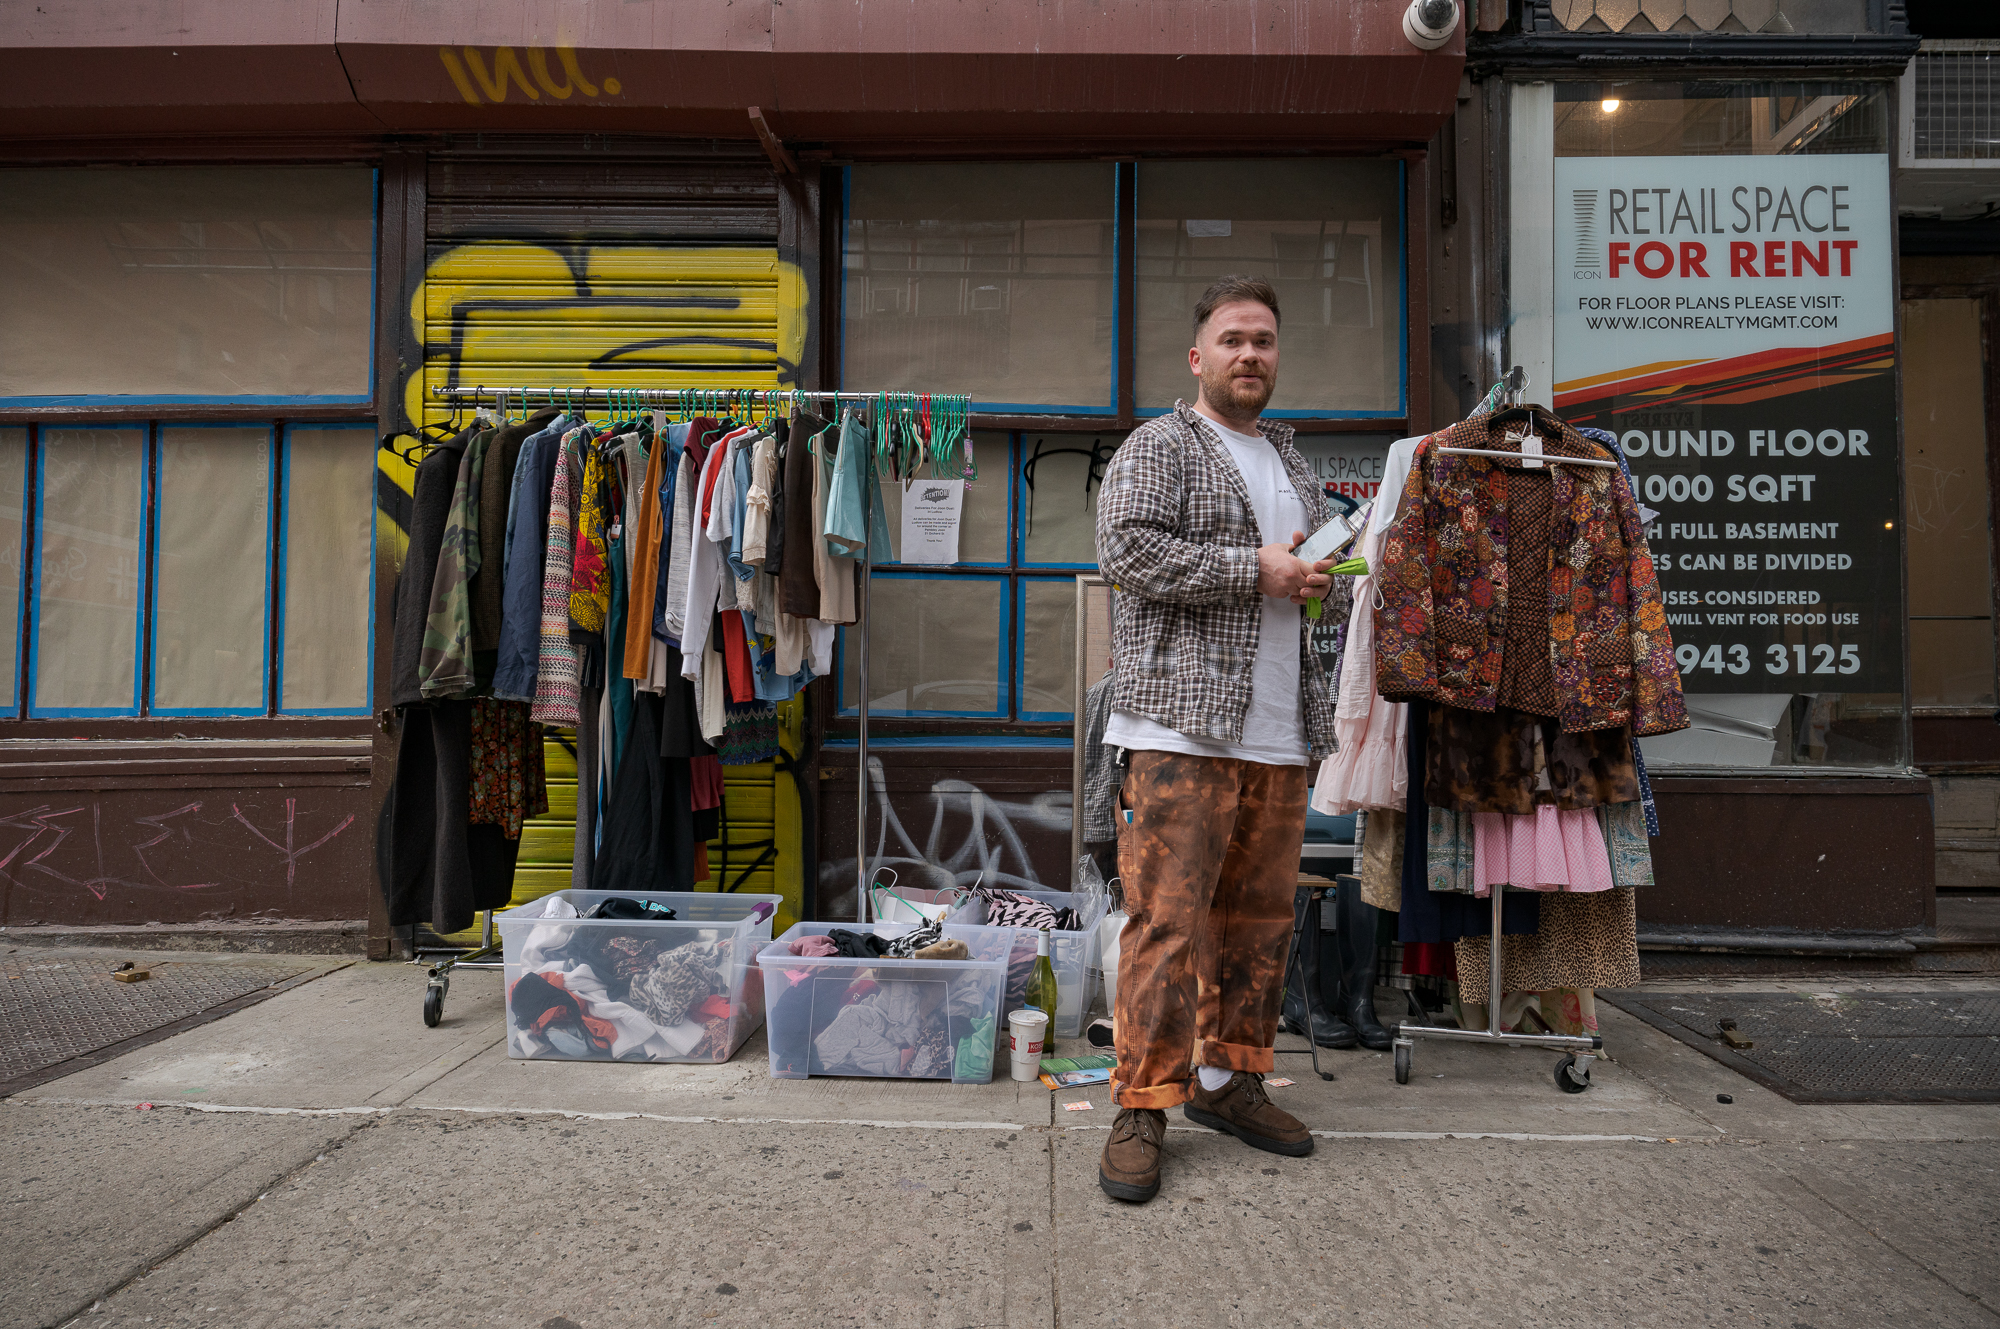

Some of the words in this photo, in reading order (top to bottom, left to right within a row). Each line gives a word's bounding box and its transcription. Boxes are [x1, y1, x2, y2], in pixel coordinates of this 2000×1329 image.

[1610, 187, 1725, 234] RETAIL
[1731, 185, 1850, 233] SPACE
[1609, 240, 1710, 279] FOR
[1730, 240, 1859, 278] RENT
[1573, 270, 1602, 280] ICON
[1579, 297, 1612, 310] FOR
[1617, 297, 1671, 310] FLOOR
[1675, 297, 1730, 310] PLANS
[1735, 296, 1797, 309] PLEASE
[1800, 296, 1845, 309] VISIT:
[1586, 315, 1838, 330] WWW.ICONREALTYMGMT.COM
[1605, 429, 1735, 457] OUND
[1749, 429, 1871, 457] FLOOR
[1328, 456, 1381, 479] SPACE
[1727, 474, 1816, 503] SQFT
[1670, 523, 1719, 540] FULL
[1725, 523, 1839, 540] BASEMENT
[1679, 553, 1726, 571] CAN
[1733, 554, 1758, 571] BE
[1766, 554, 1852, 570] DIVIDED
[1704, 590, 1821, 605] CONSIDERED
[1666, 613, 1702, 625] WILL
[1706, 613, 1745, 625] VENT
[1750, 613, 1780, 625] FOR
[1784, 613, 1827, 625] FOOD
[1832, 613, 1859, 625] USE
[1675, 643, 1751, 675] 943
[1766, 643, 1861, 675] 3125
